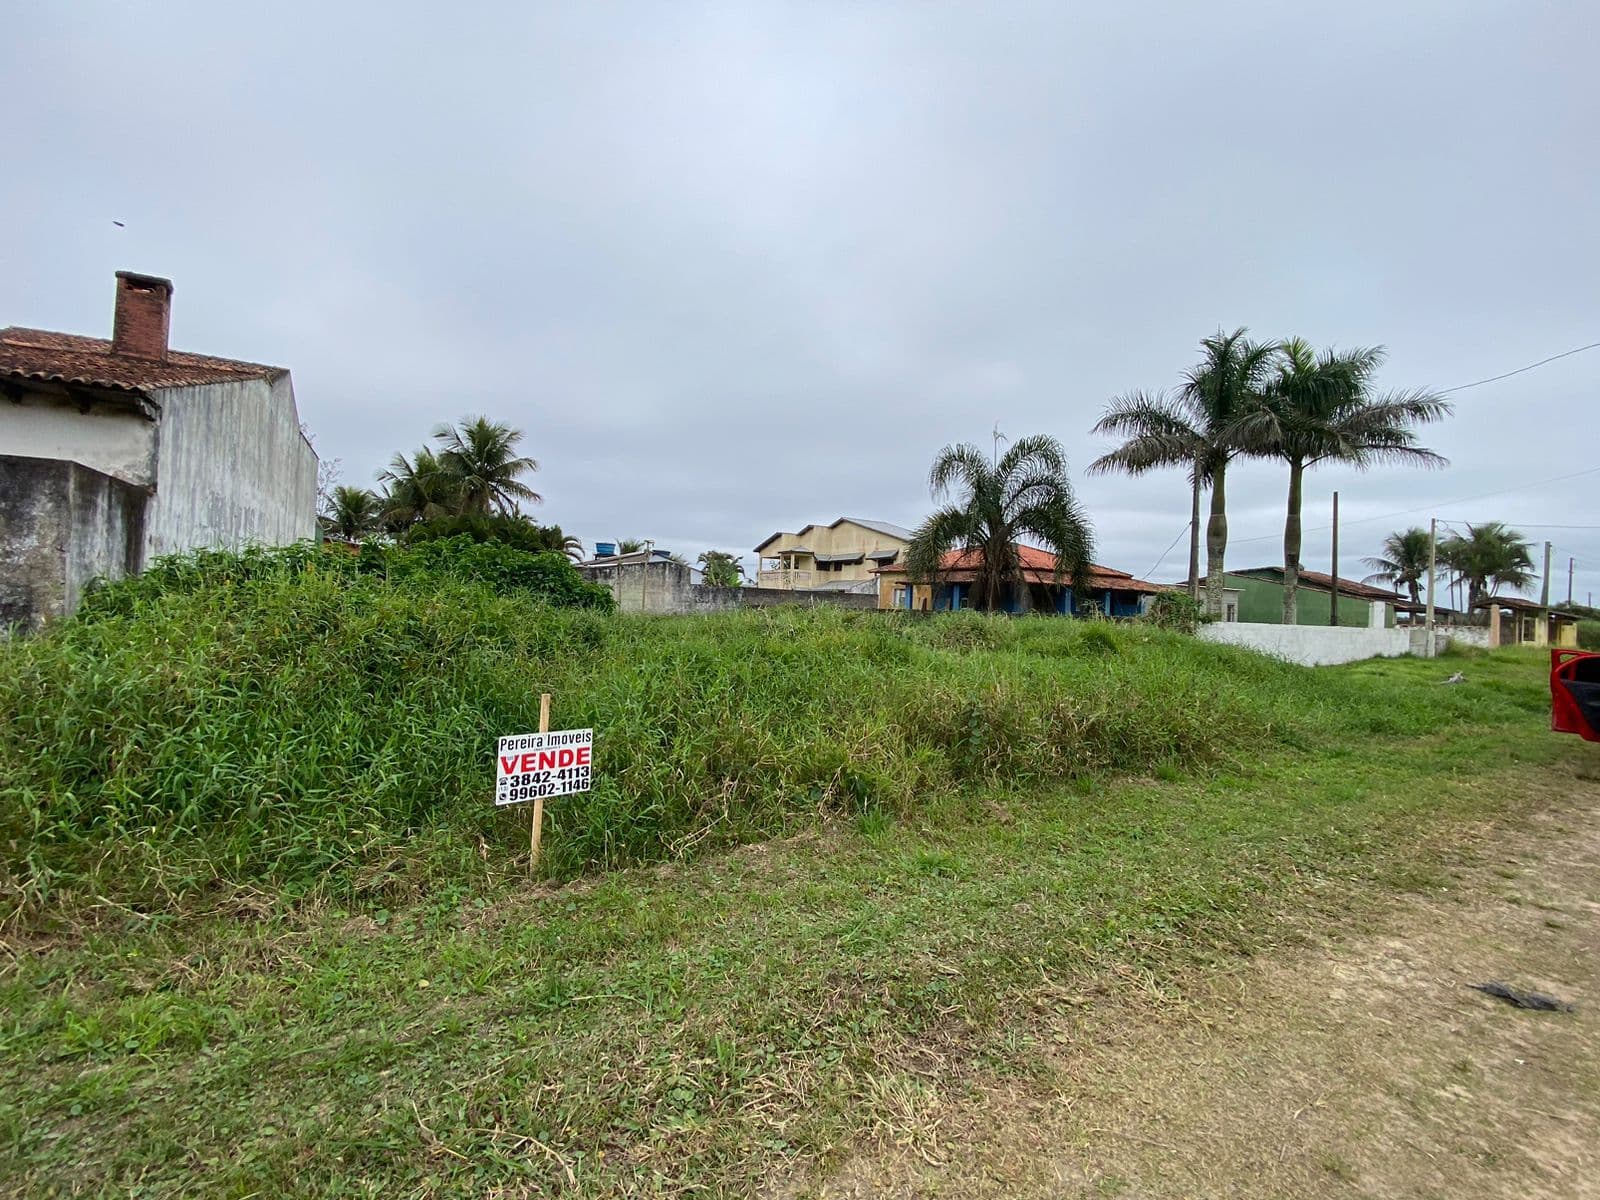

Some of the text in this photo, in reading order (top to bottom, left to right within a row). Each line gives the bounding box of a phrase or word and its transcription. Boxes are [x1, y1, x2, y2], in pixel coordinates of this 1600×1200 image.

[500, 735, 543, 751] Pereira
[547, 730, 592, 746] Imoveis
[500, 747, 590, 775] VENDE
[510, 766, 590, 788] 3842-4113
